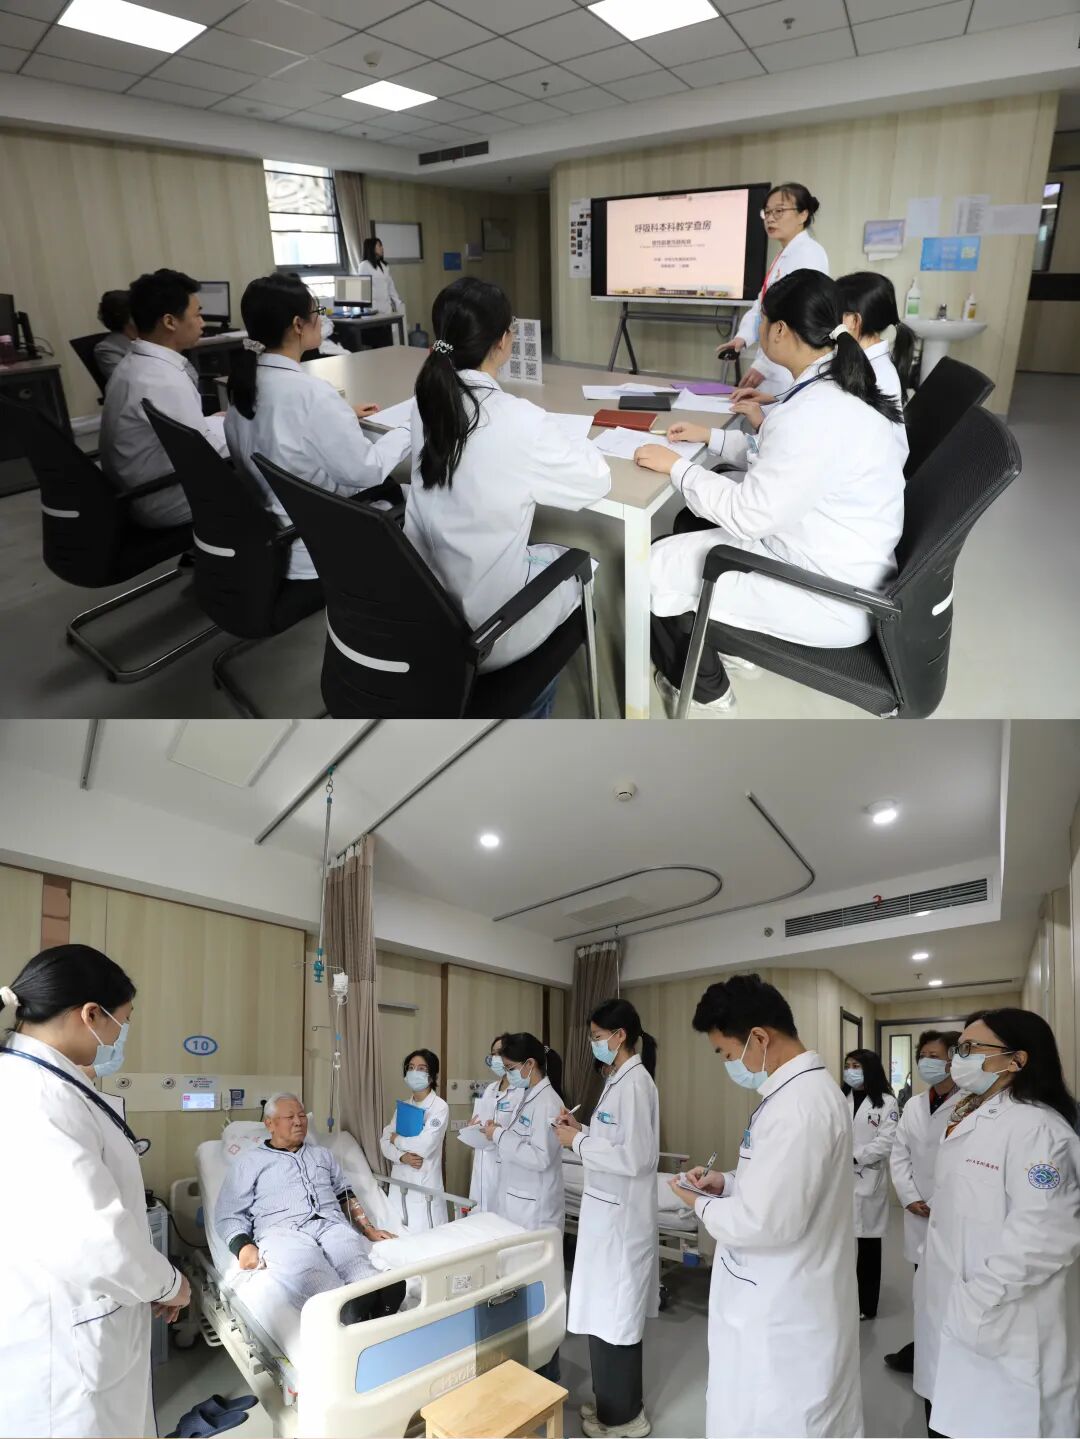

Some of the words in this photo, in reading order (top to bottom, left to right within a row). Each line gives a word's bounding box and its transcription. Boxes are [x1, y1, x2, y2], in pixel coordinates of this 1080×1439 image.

[634, 220, 712, 233] 呼吸科本科教学查房
[193, 1040, 209, 1051] 10
